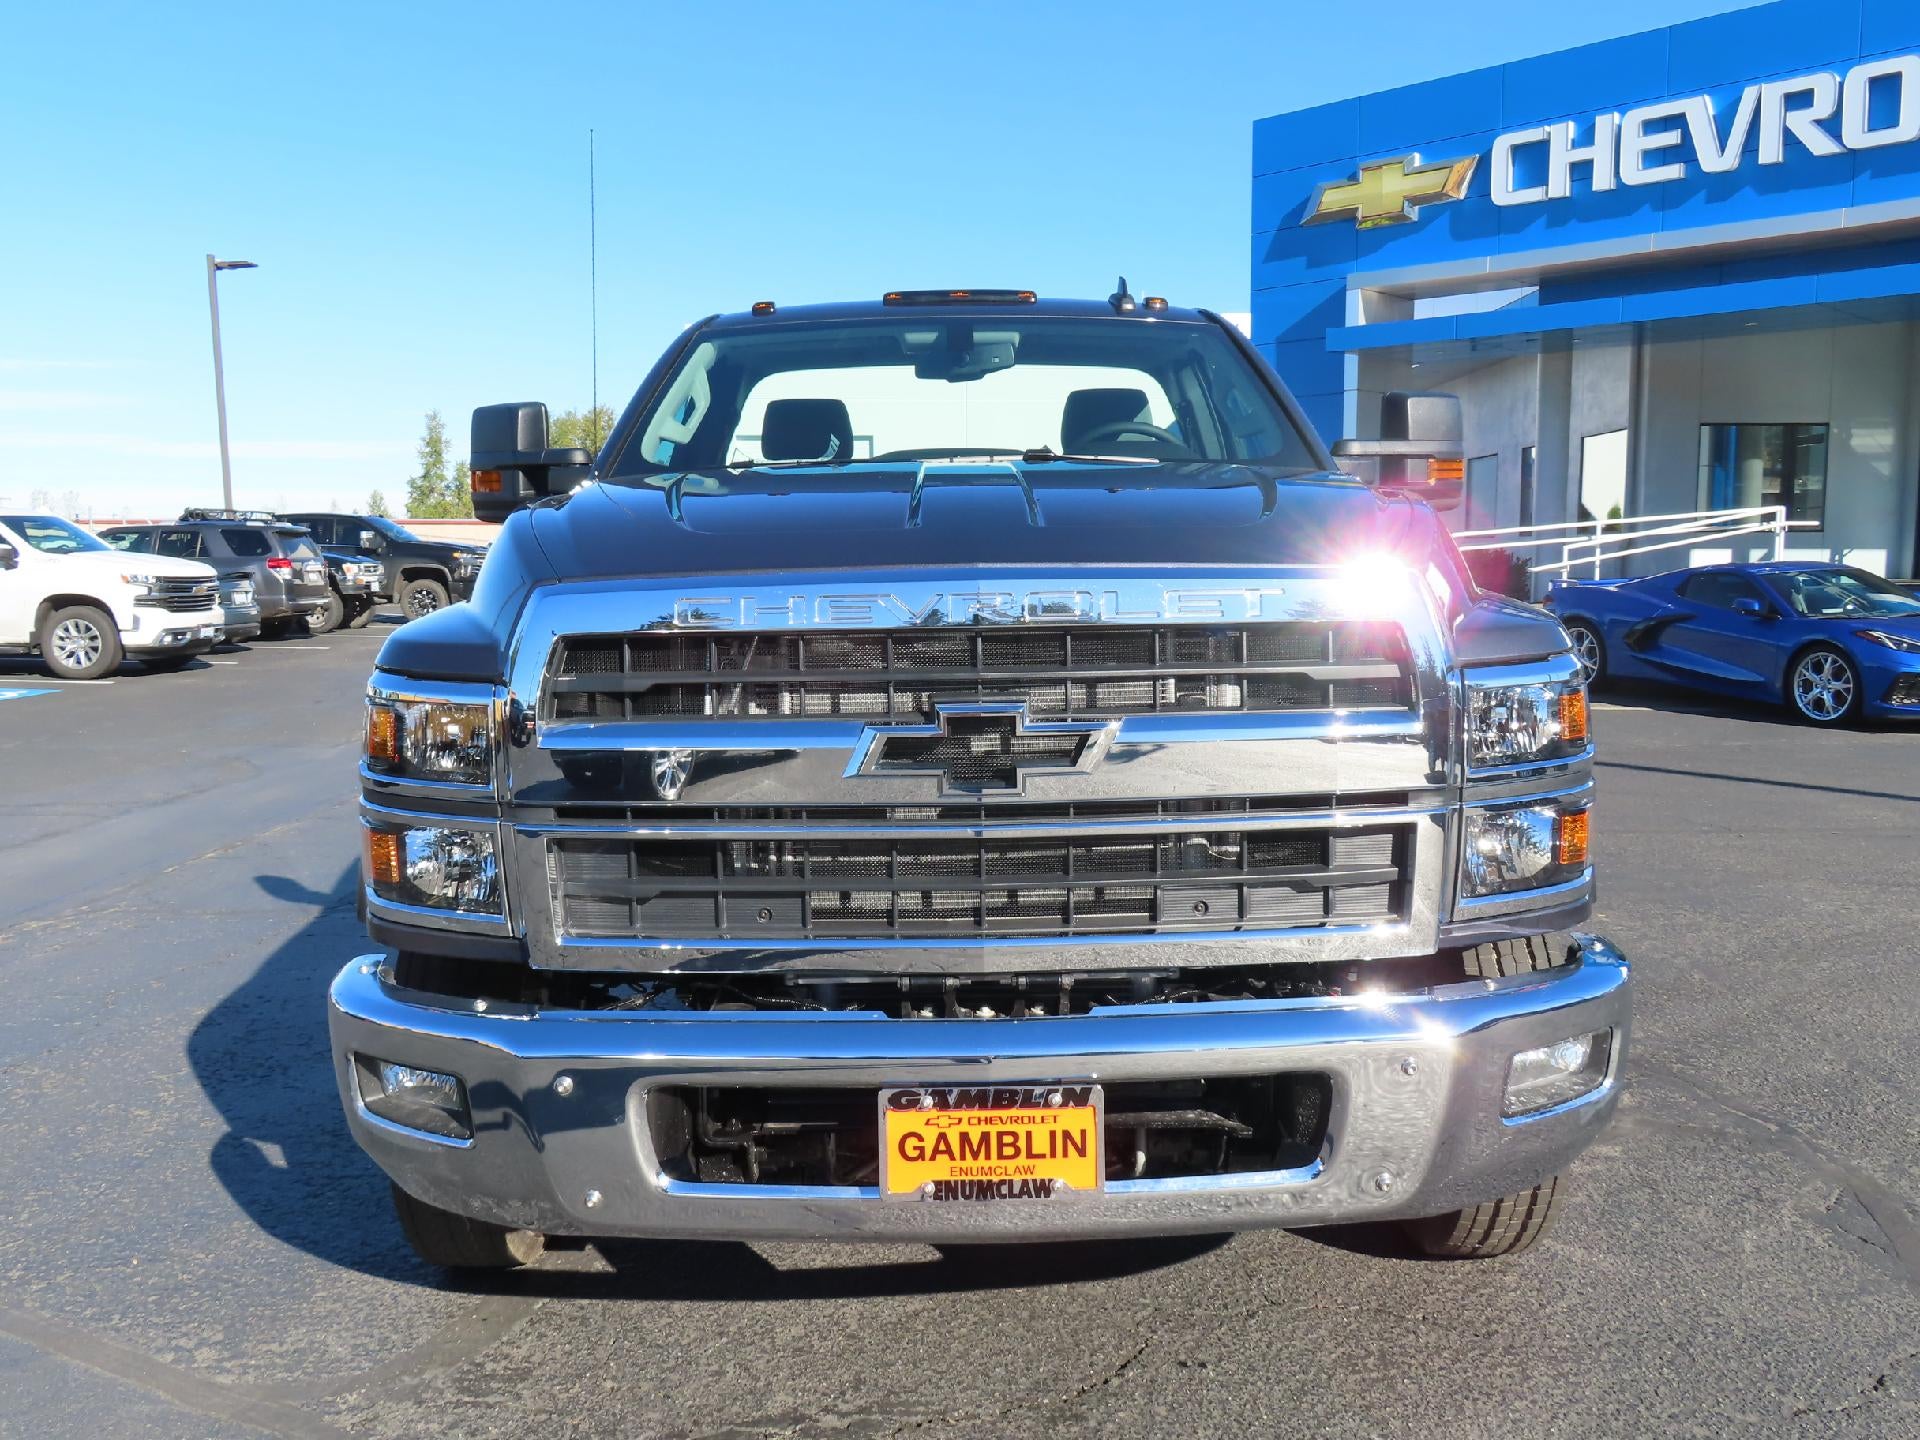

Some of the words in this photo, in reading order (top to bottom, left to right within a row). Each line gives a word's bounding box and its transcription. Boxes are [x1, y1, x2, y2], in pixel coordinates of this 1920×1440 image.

[1491, 53, 1920, 206] CHEVRO
[672, 587, 1286, 627] CHEVROLET
[888, 1087, 1094, 1110] GAMBLIN
[967, 1115, 1060, 1126] CHEVROLET
[898, 1129, 1087, 1162] GAMBLIN
[950, 1165, 1036, 1177] ENUMCLAW
[933, 1178, 1052, 1200] ENUMCLAW
